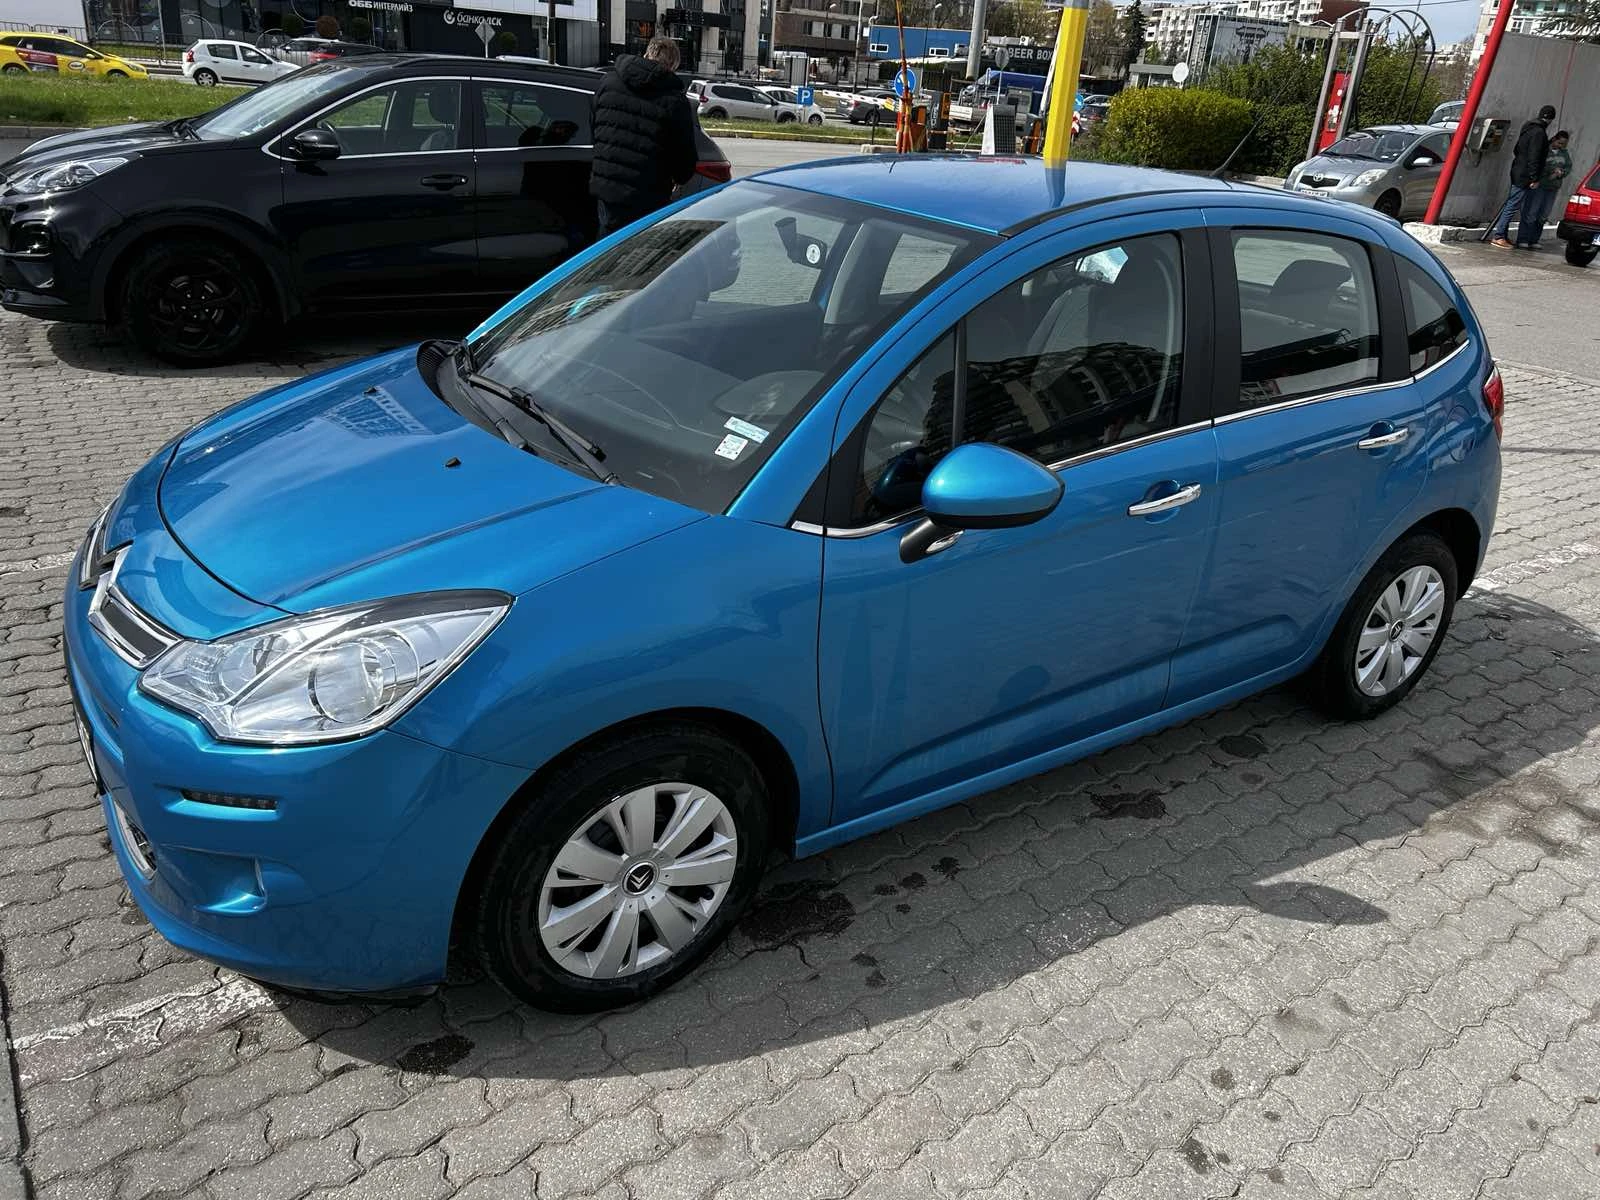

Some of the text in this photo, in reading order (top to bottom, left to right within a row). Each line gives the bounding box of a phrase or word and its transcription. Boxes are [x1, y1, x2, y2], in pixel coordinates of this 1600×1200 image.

[1008, 47, 1053, 60] BEER BOX
[801, 90, 811, 103] P
